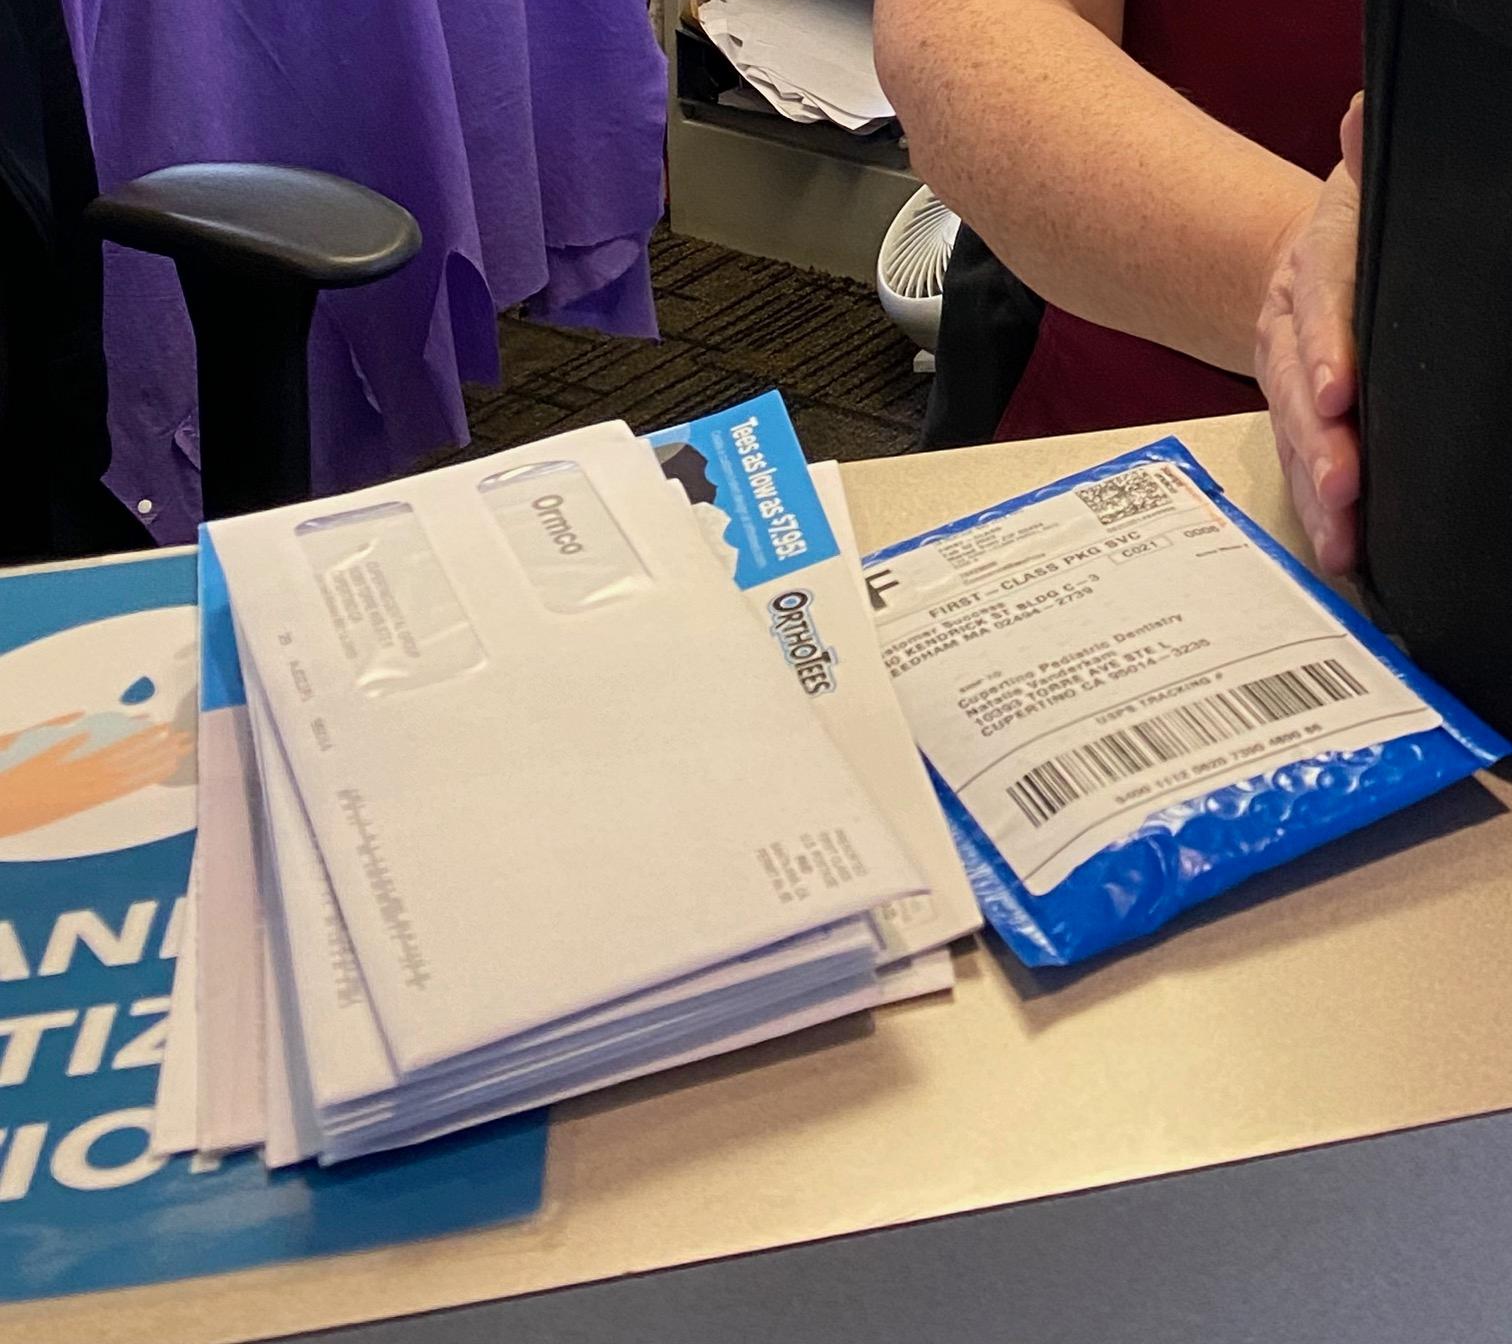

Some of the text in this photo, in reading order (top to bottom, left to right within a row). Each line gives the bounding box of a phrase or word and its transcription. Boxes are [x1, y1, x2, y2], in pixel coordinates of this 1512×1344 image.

[729, 415, 760, 457] Tees
[741, 452, 768, 476] as
[748, 465, 778, 500] low
[531, 493, 583, 555] Ormco
[759, 497, 785, 519] as
[768, 512, 809, 562] $7.95!
[1063, 545, 1101, 566] PKG
[1104, 529, 1141, 550] SVC
[1121, 539, 1157, 558] C021
[903, 616, 988, 657] KENDRICK
[1015, 588, 1060, 612] BLDG
[888, 637, 958, 678] EEDHAM
[963, 625, 990, 641] MA
[956, 611, 1183, 710] Cupertino Pediatric Dentistry
[1088, 659, 1119, 677] AVE
[1123, 645, 1153, 663] STE
[979, 688, 1076, 738] CUPERTINO
[1080, 675, 1105, 692] CA
